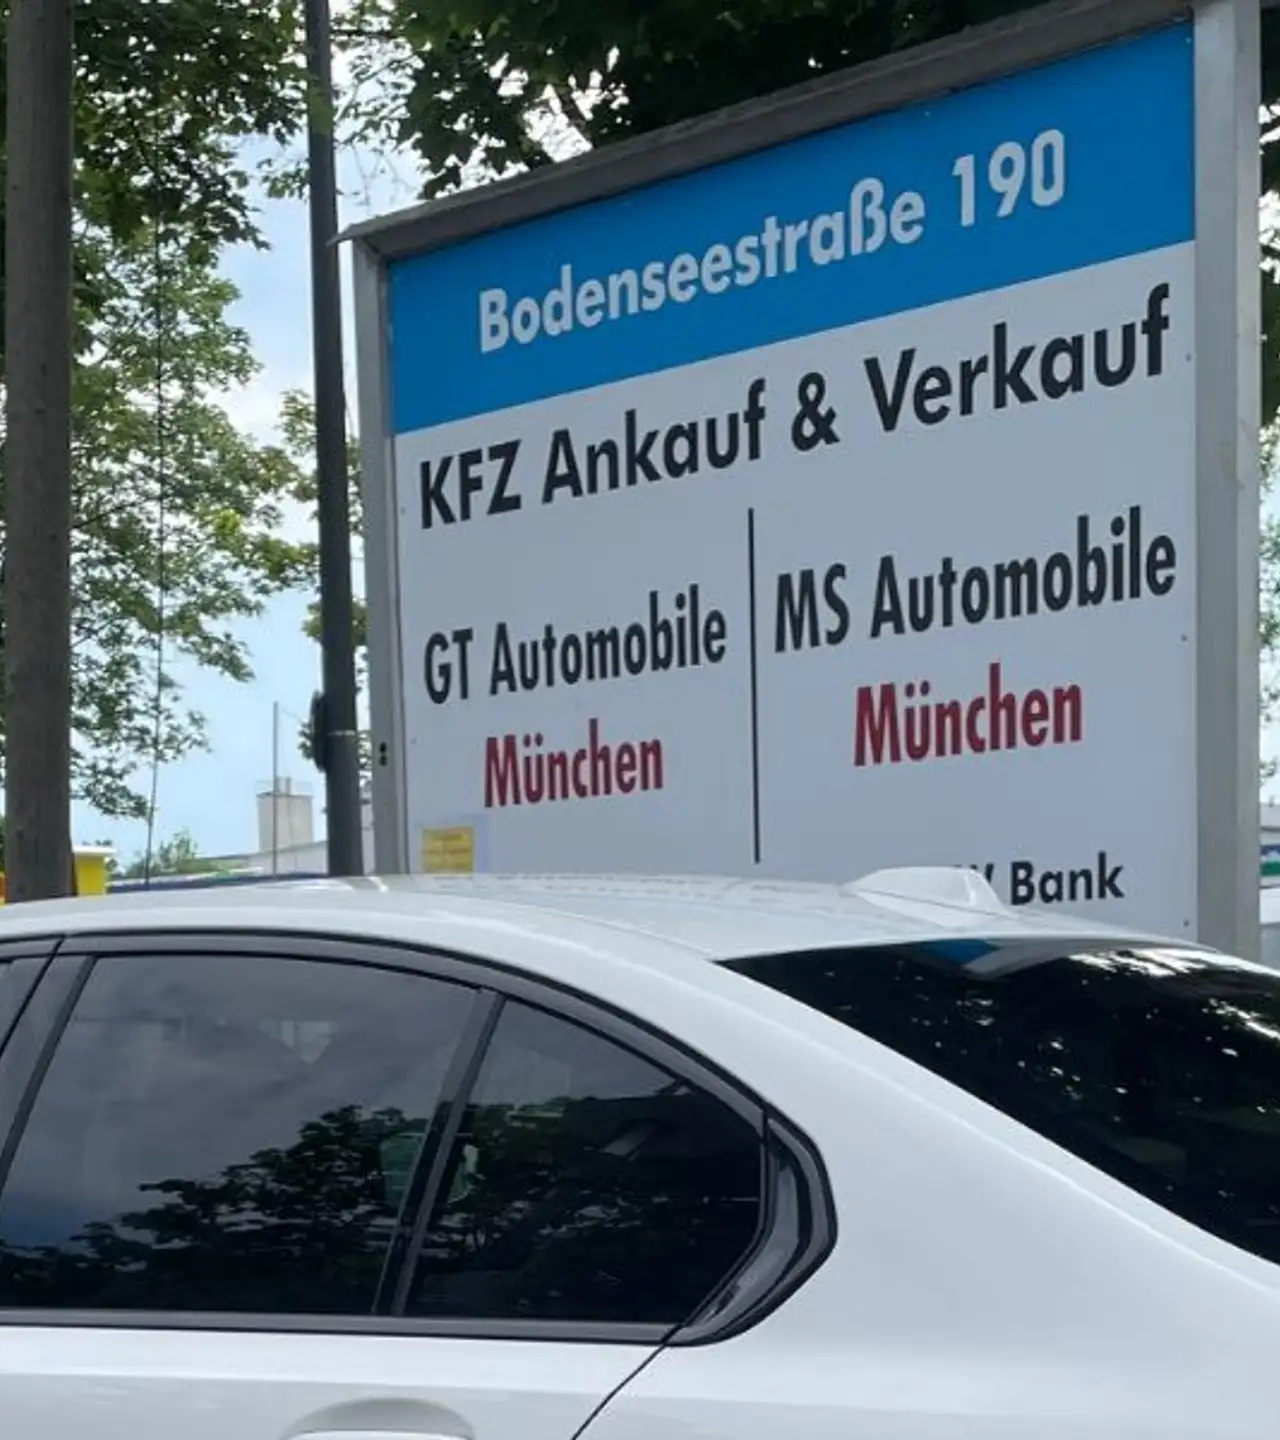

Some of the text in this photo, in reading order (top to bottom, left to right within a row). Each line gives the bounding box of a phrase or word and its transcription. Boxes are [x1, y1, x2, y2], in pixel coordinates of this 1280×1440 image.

[480, 128, 1066, 354] Bodenseestraße 190
[420, 282, 1170, 530] KFZ Ankauf & Verkauf
[775, 505, 1177, 653] MS Automobile
[424, 583, 727, 704] GT Automobile
[484, 718, 664, 808] München
[854, 662, 1083, 767] München
[1010, 850, 1125, 907] Bank
